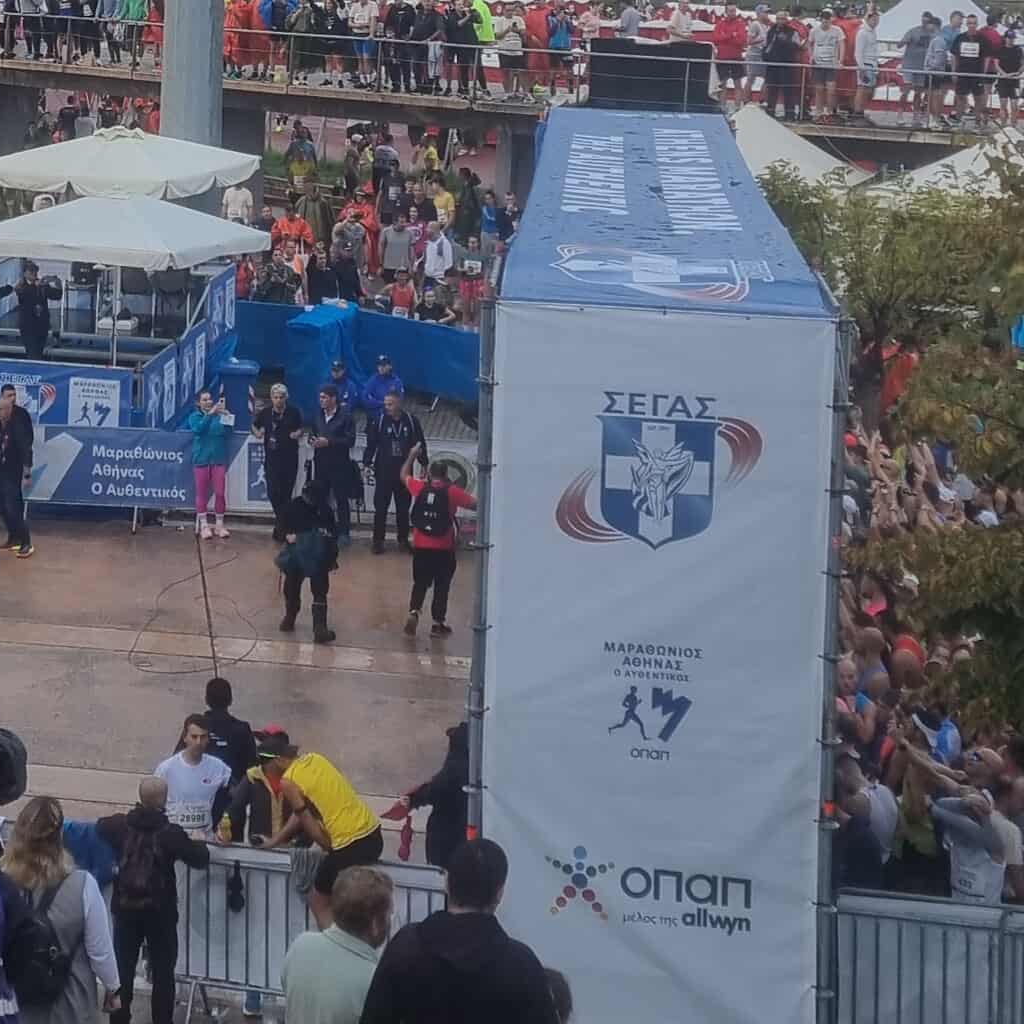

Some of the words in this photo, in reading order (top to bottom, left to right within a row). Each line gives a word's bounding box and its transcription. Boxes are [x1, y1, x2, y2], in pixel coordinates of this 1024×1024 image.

[602, 391, 717, 419] ΣΕΓΑΣ
[92, 445, 184, 464] Μαραθώνιος
[92, 463, 144, 480] Αθήνας
[91, 482, 103, 495] Ο
[106, 483, 186, 501] Αυθεντικός
[604, 641, 704, 659] ΜΑΡΑΘΩΝΙΟΣ
[622, 656, 683, 671] ΑΘΗΝΑΣ
[624, 669, 689, 682] ΑΥΘΕΝΤΙΚΟΣ
[623, 911, 657, 925] μέλος
[659, 915, 678, 928] της
[681, 907, 751, 936] allwyn
